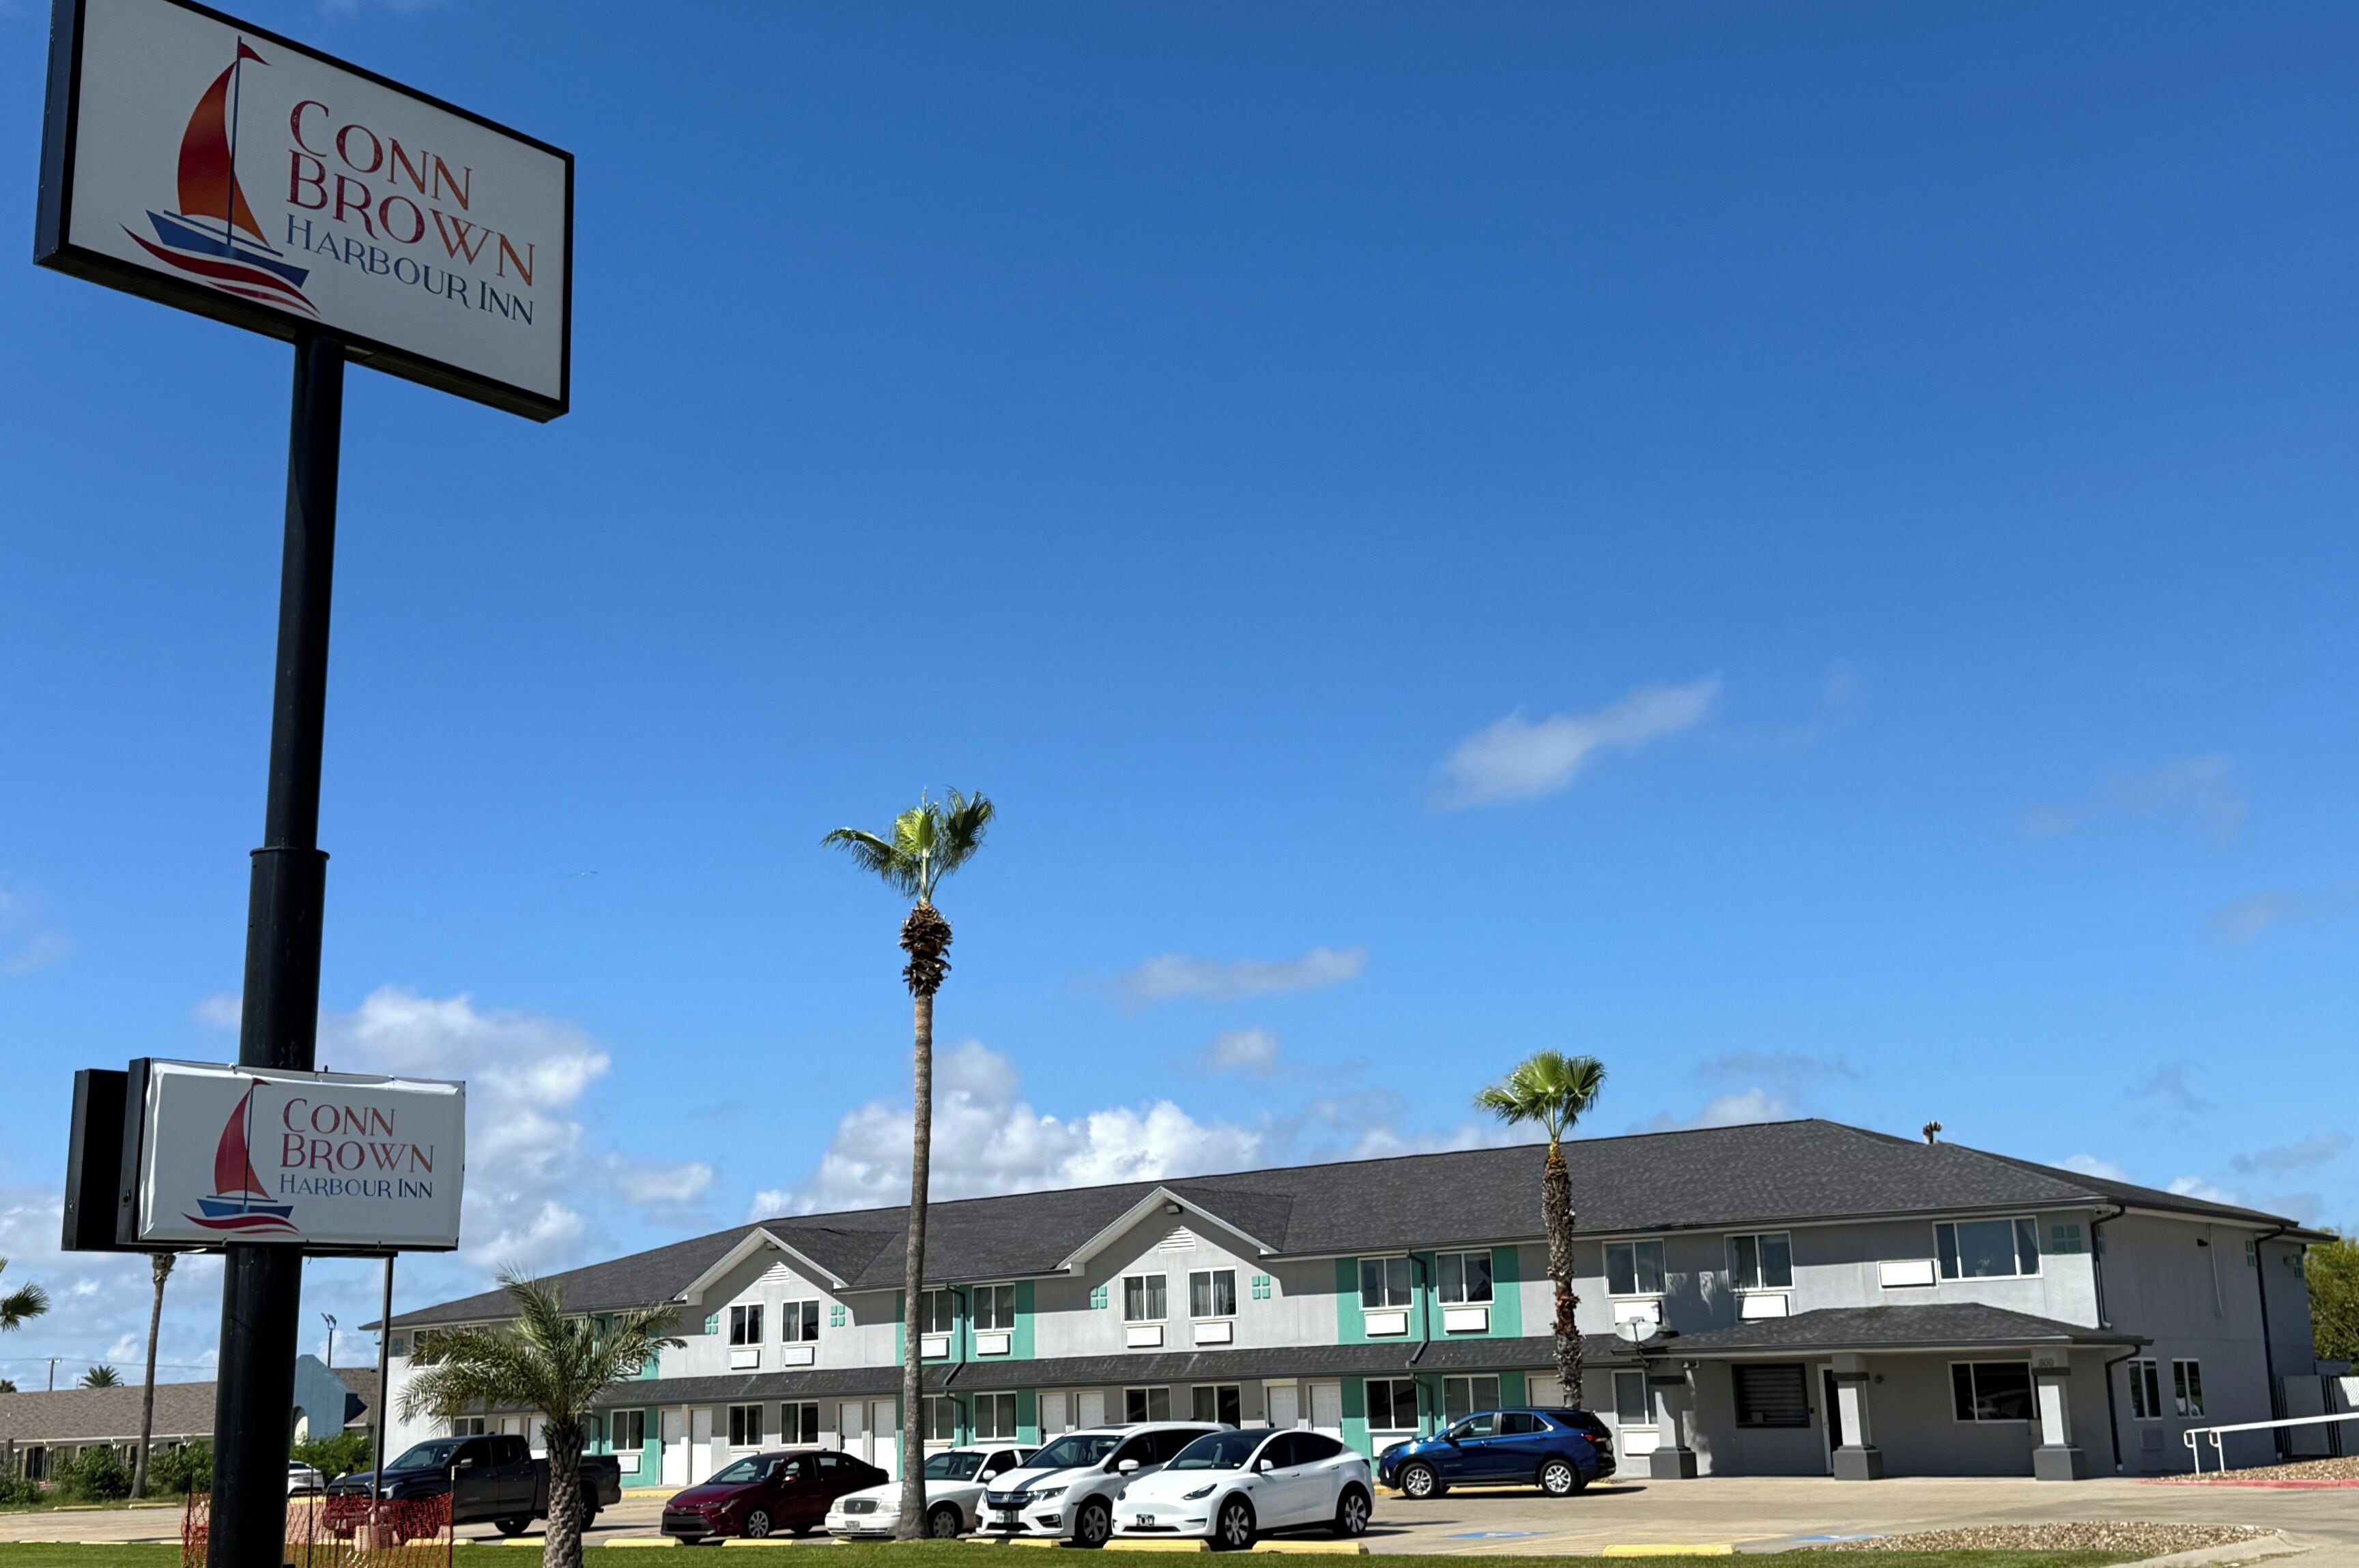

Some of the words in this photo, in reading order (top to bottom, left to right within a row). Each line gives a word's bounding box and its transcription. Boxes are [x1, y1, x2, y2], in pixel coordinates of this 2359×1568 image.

[290, 100, 472, 211] CONN
[287, 149, 535, 287] BROWN
[286, 214, 470, 309] HARBOUR
[479, 281, 533, 326] INN
[281, 1133, 434, 1174] BROWN
[283, 1098, 395, 1137] CONN
[280, 1173, 392, 1199] HARBOUR
[398, 1178, 432, 1199] INN
